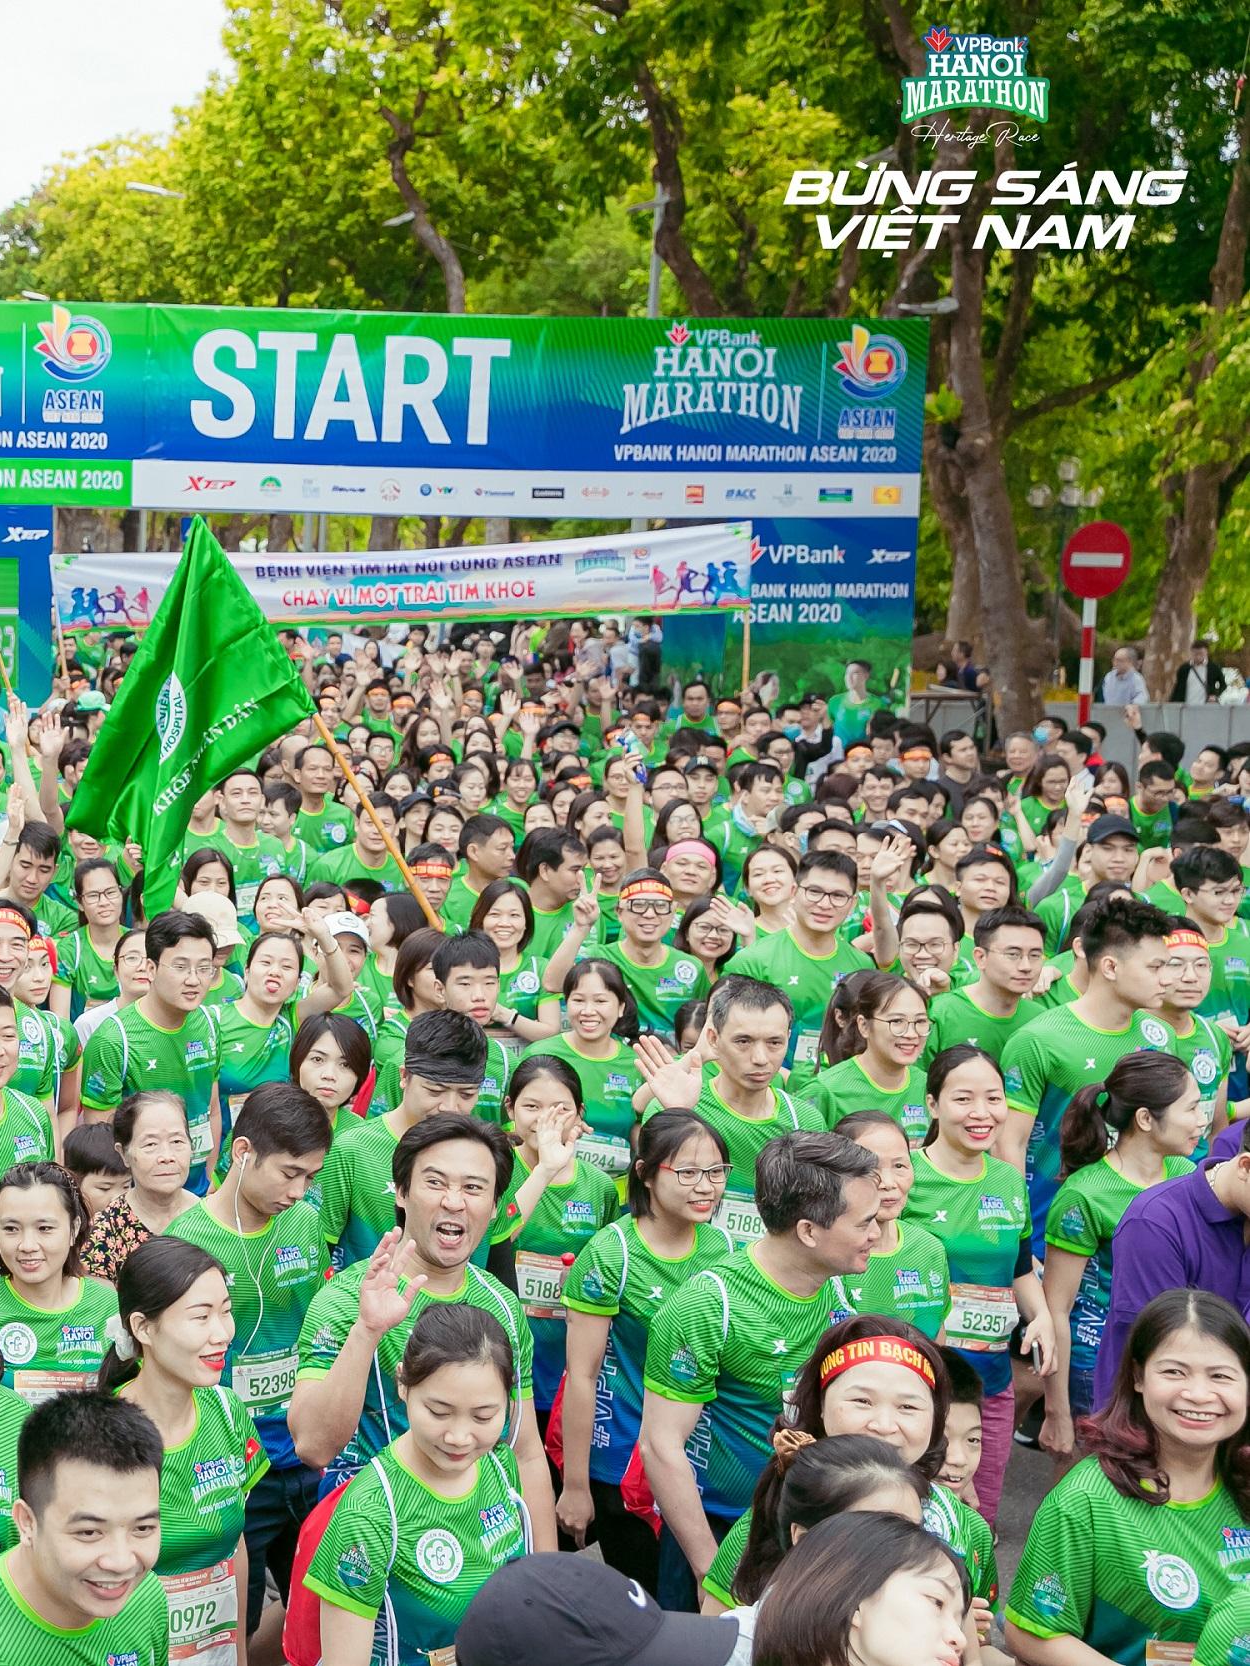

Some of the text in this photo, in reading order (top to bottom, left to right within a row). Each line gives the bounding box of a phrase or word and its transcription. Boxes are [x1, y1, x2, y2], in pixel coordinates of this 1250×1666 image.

[694, 329, 761, 347] VPBank
[653, 347, 778, 378] HANOI
[189, 328, 512, 446] START
[44, 390, 103, 411] ASEAN
[620, 382, 803, 435] MARATHON
[839, 407, 896, 428] ASEAN
[16, 431, 67, 449] ASEAN
[71, 432, 108, 450] 2020
[614, 444, 897, 463] VPBANK HANOI MARATHON ASEAN 2020
[20, 469, 76, 489] ASEAN
[80, 470, 123, 490] 2020
[351, 563, 381, 576] TIM
[502, 552, 562, 569] ASEAN
[768, 543, 846, 565] VPBank
[448, 581, 480, 601] TIM
[791, 582, 910, 599] HANOI MARATHON
[810, 602, 842, 624] 2020
[163, 692, 182, 753] HOSPITAL
[726, 1212, 767, 1235] 5188
[278, 1250, 302, 1263] HANOI
[962, 1310, 1007, 1333] 52351
[63, 1331, 95, 1341] HANOI
[56, 1340, 103, 1355] MARATHON
[847, 1341, 922, 1366] TIN BẠCH
[250, 1368, 296, 1398] 52398
[197, 1464, 230, 1484] HANOI
